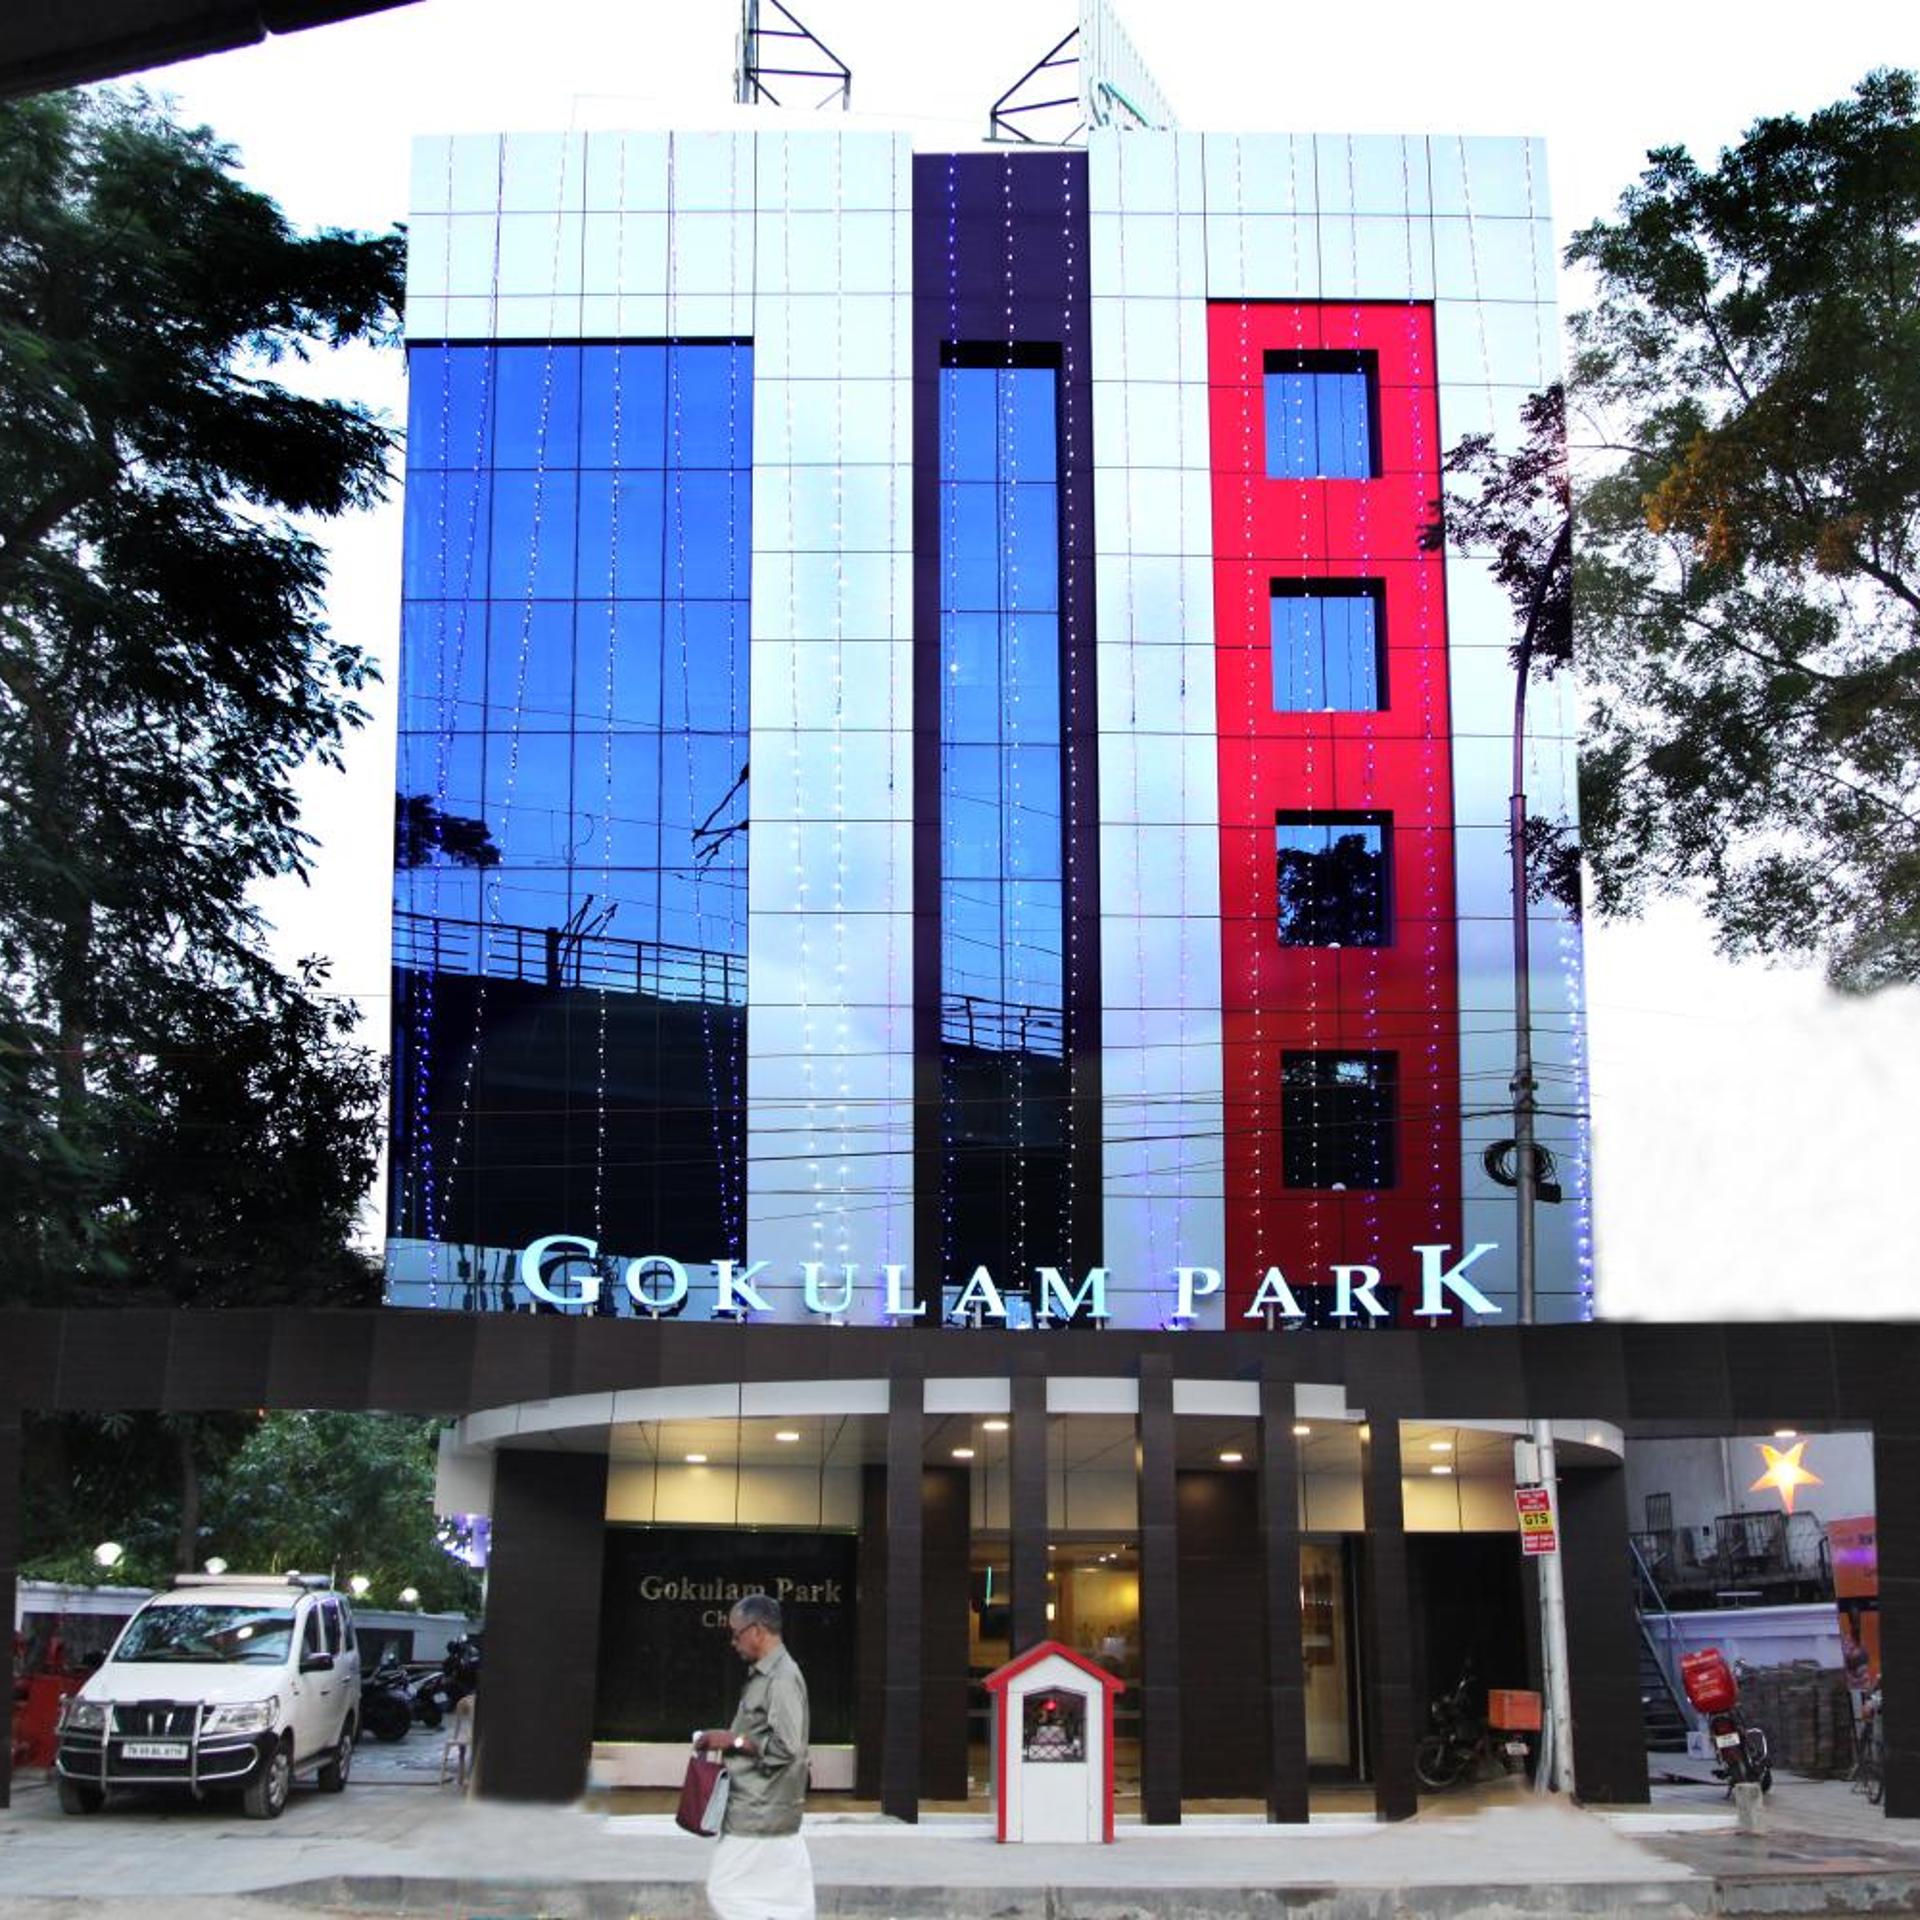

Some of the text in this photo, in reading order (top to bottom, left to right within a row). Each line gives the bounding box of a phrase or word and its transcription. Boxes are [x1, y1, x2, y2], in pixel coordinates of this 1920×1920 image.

[521, 1234, 1502, 1318] GOKULAM PARK
[1523, 1512, 1549, 1525] GTS
[640, 1576, 842, 1602] Gokulam Park
